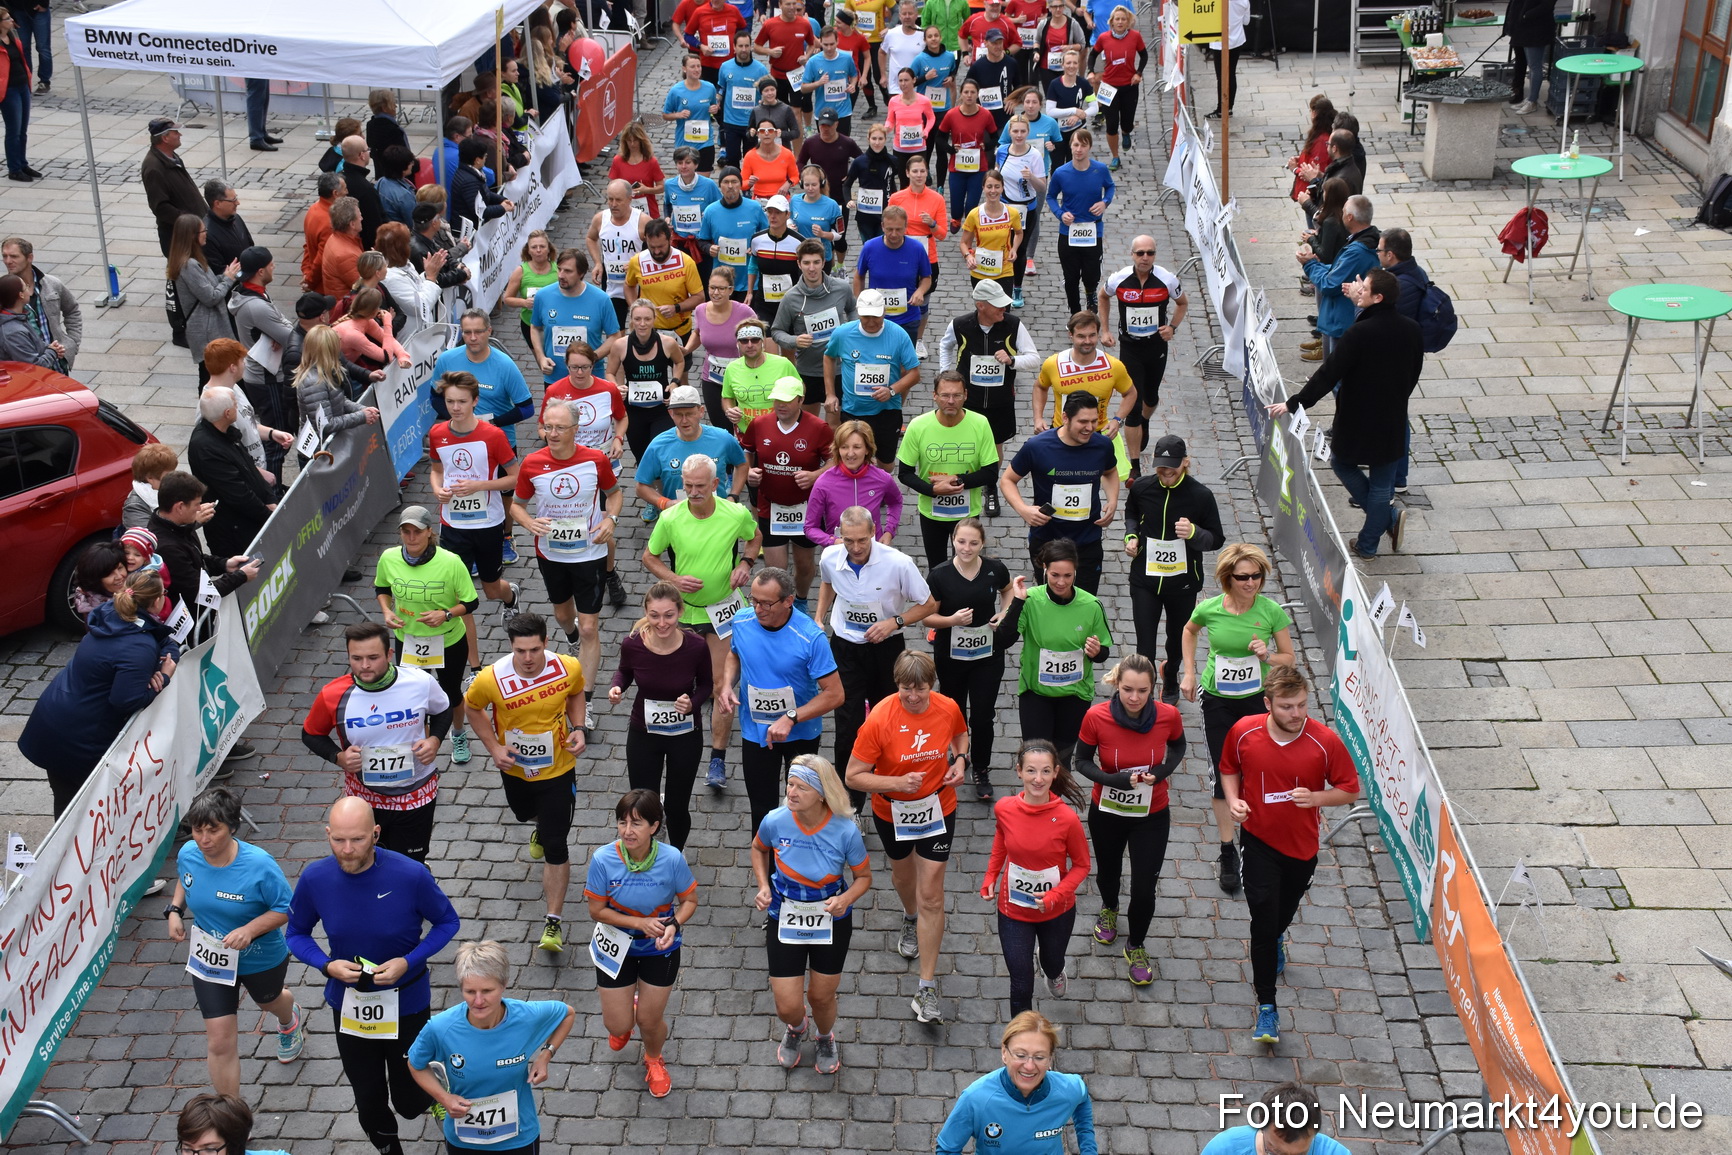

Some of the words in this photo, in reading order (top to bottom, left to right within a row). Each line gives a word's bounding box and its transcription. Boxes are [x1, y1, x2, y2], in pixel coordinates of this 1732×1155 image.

[1193, 2, 1215, 14] lauf
[84, 28, 133, 46] BMW
[137, 32, 278, 56] ConnectedDrive
[711, 41, 727, 49] 2526
[87, 47, 144, 64] Vernetzt,
[145, 53, 165, 64] um
[167, 52, 187, 65] frei
[190, 57, 204, 65] zu
[206, 55, 235, 68] sein.
[1050, 57, 1063, 65] 254
[827, 85, 844, 94] 2941
[735, 93, 753, 102] 2938
[930, 93, 942, 101] 171
[981, 93, 998, 102] 2394
[692, 126, 702, 135] 84
[902, 130, 919, 140] 2934
[961, 155, 975, 164] 100
[860, 196, 879, 205] 2037
[677, 213, 697, 223] 2552
[979, 225, 994, 233] MAX
[1073, 229, 1093, 238] 2602
[725, 245, 740, 256] 164
[980, 256, 996, 267] 268
[642, 276, 662, 286] MAX
[663, 270, 686, 282] BÖGL
[771, 283, 782, 292] 81
[883, 297, 900, 306] 135
[811, 318, 835, 331] 2079
[1130, 315, 1153, 326] 2141
[638, 365, 655, 374] RUN
[974, 364, 1000, 375] 2355
[860, 373, 885, 384] 2568
[1060, 377, 1084, 388] MAX
[1087, 372, 1113, 383] BÖGL
[633, 390, 658, 401] 2724
[452, 498, 481, 511] 2475
[937, 494, 965, 506] 2906
[1065, 495, 1080, 507] 29
[776, 511, 803, 523] 2509
[552, 528, 582, 540] 2474
[1155, 550, 1177, 563] 228
[245, 548, 294, 641] BOCK
[715, 599, 742, 624] 2500
[846, 610, 878, 623] 2656
[957, 635, 987, 648] 2360
[415, 644, 430, 656] 22
[1045, 660, 1077, 673] 2185
[1221, 667, 1254, 681] 2797
[505, 695, 536, 711] MAX
[538, 681, 571, 699] BÖGL
[754, 699, 787, 712] 2351
[230, 712, 246, 736] GmbH
[346, 708, 420, 730] RÖDL
[386, 717, 420, 730] energie
[651, 711, 687, 725] 2350
[511, 741, 547, 756] 2629
[900, 749, 939, 763] funrunners
[912, 753, 945, 764] neumarkt
[369, 755, 406, 771] 2177
[1108, 788, 1143, 804] 5021
[899, 806, 934, 825] 2227
[1014, 878, 1053, 894] 2240
[216, 890, 245, 901] BOCK
[786, 912, 825, 927] 2107
[594, 926, 620, 958] 2259
[195, 942, 230, 967] 2405
[39, 976, 94, 1062] Service-Line:
[352, 1004, 385, 1021] 190
[359, 1023, 377, 1032] André
[496, 1053, 526, 1067] BOCK
[464, 1106, 507, 1126] 2471
[1034, 1126, 1064, 1139] BOCK
